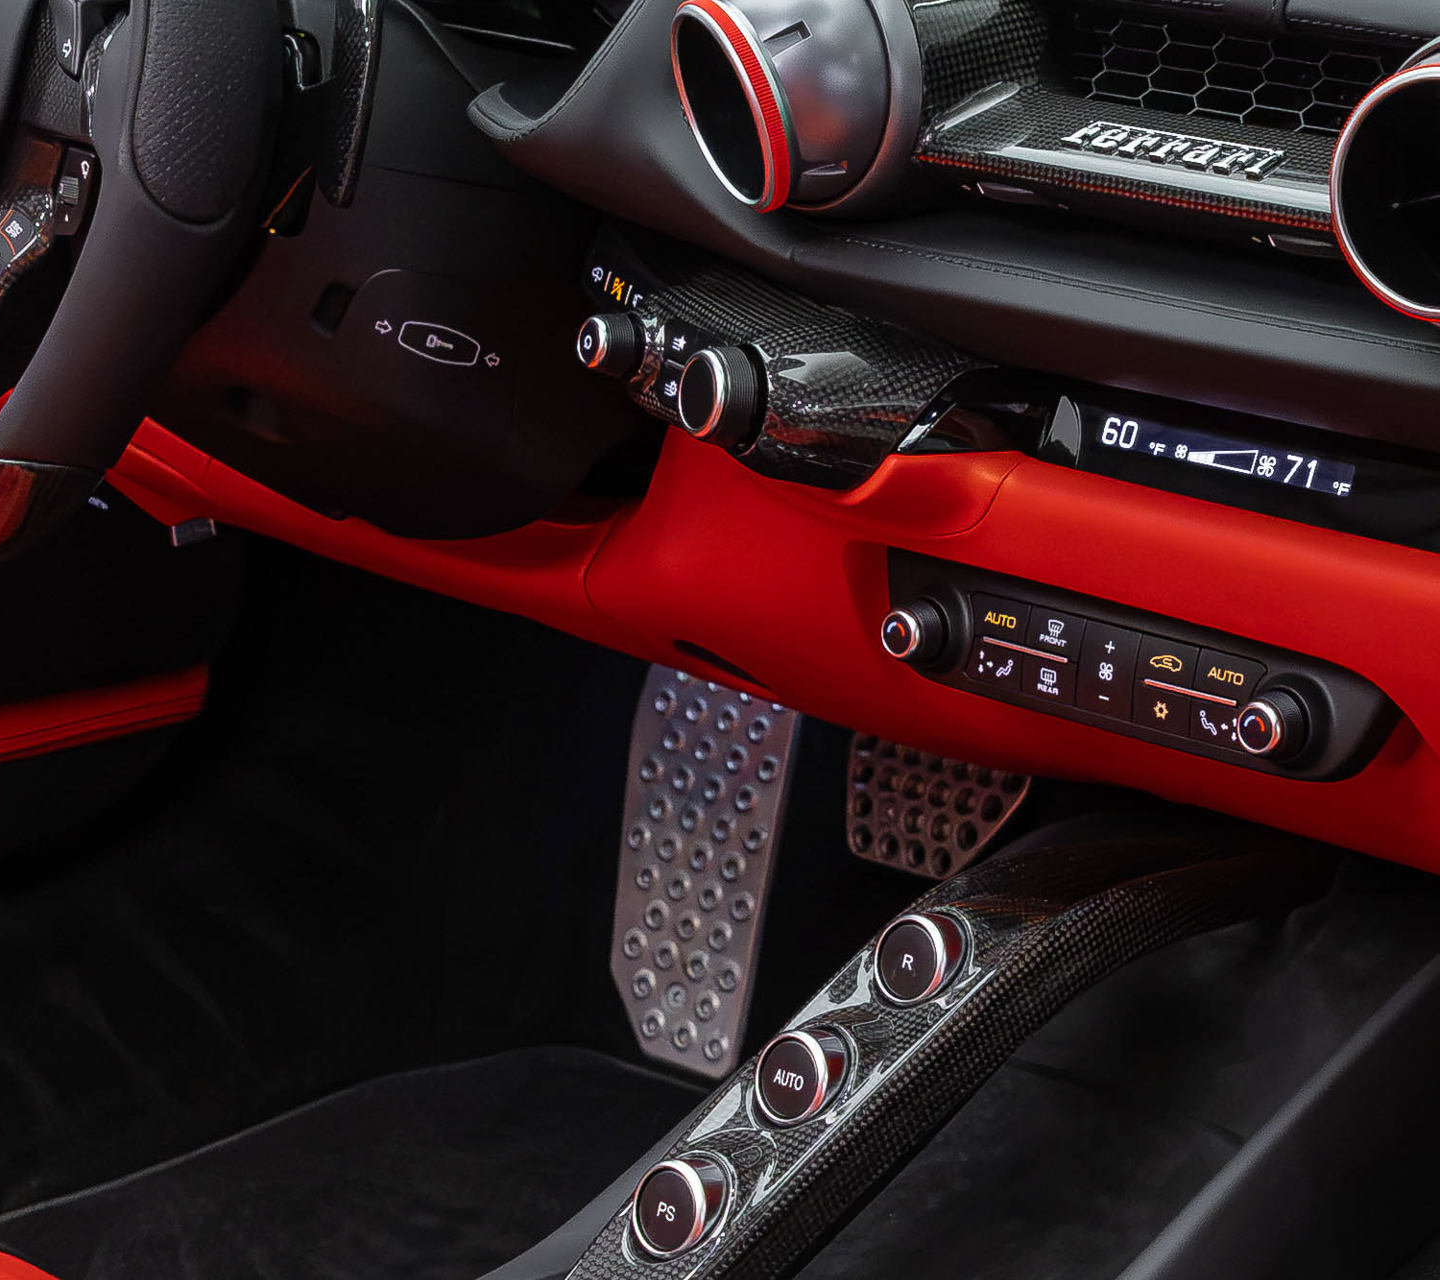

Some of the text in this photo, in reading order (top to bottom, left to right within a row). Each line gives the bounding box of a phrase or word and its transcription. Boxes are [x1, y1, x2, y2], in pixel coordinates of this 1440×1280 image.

[1061, 120, 1288, 181] Ferrari
[1100, 416, 1138, 450] 60
[1284, 454, 1319, 488] 71
[984, 610, 1017, 629] AUTO
[1039, 633, 1067, 648] FRONT
[1207, 665, 1244, 686] AUTO
[1037, 683, 1059, 696] REAR
[902, 953, 913, 971] R
[773, 1069, 804, 1091] AUTO
[656, 1200, 676, 1222] PS
